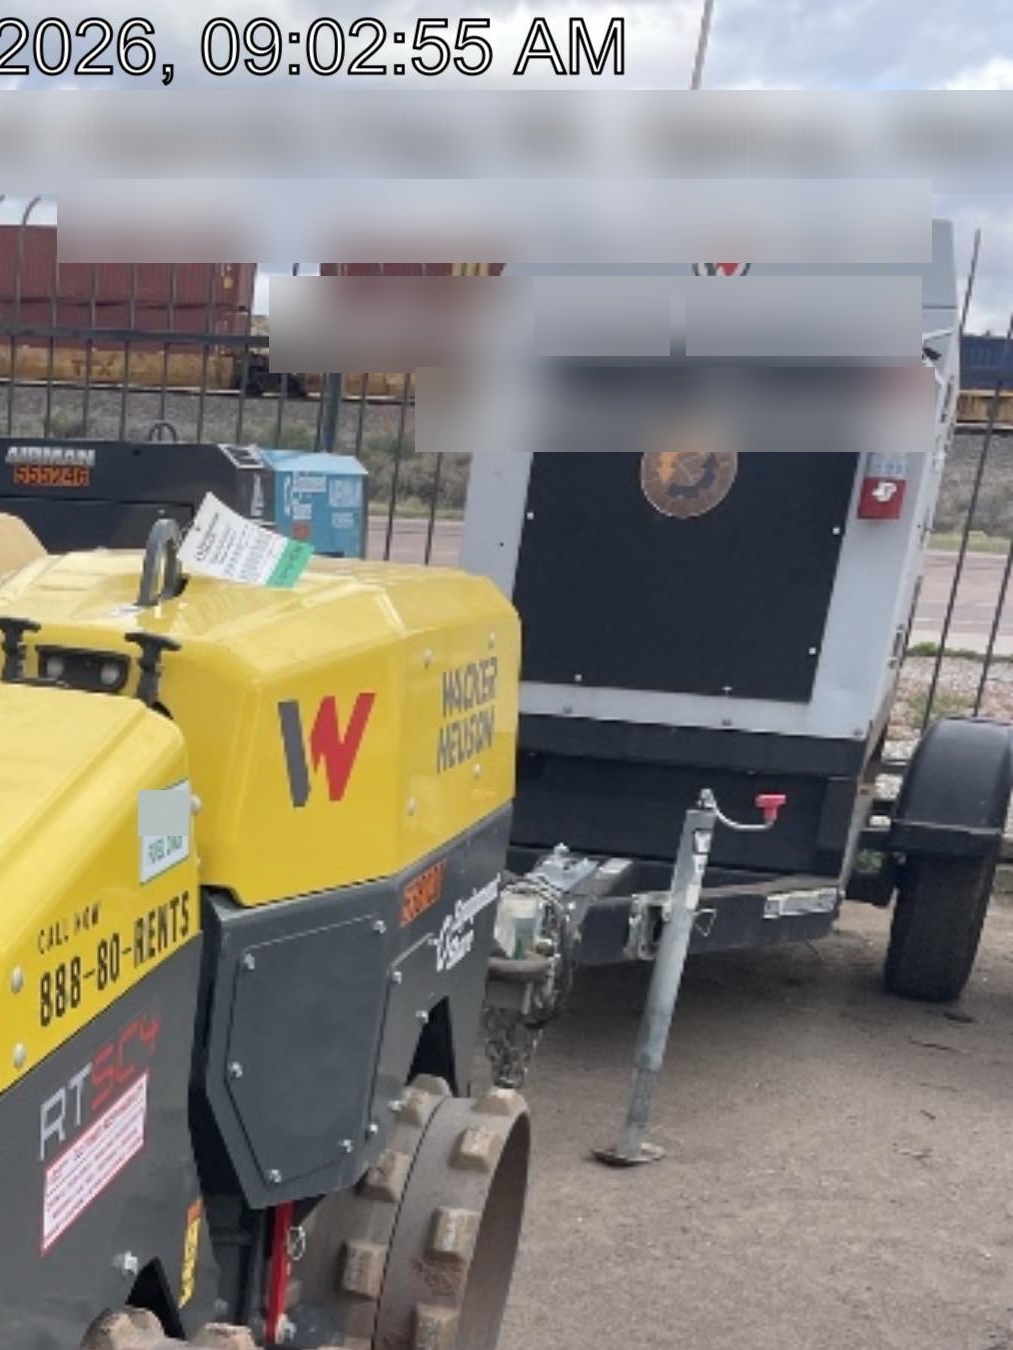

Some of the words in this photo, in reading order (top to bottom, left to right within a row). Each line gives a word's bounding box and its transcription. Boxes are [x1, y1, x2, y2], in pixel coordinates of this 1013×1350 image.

[442, 658, 498, 719] WACKER
[436, 704, 495, 775] NEUSON
[40, 889, 190, 1027] 888-80-RENTS
